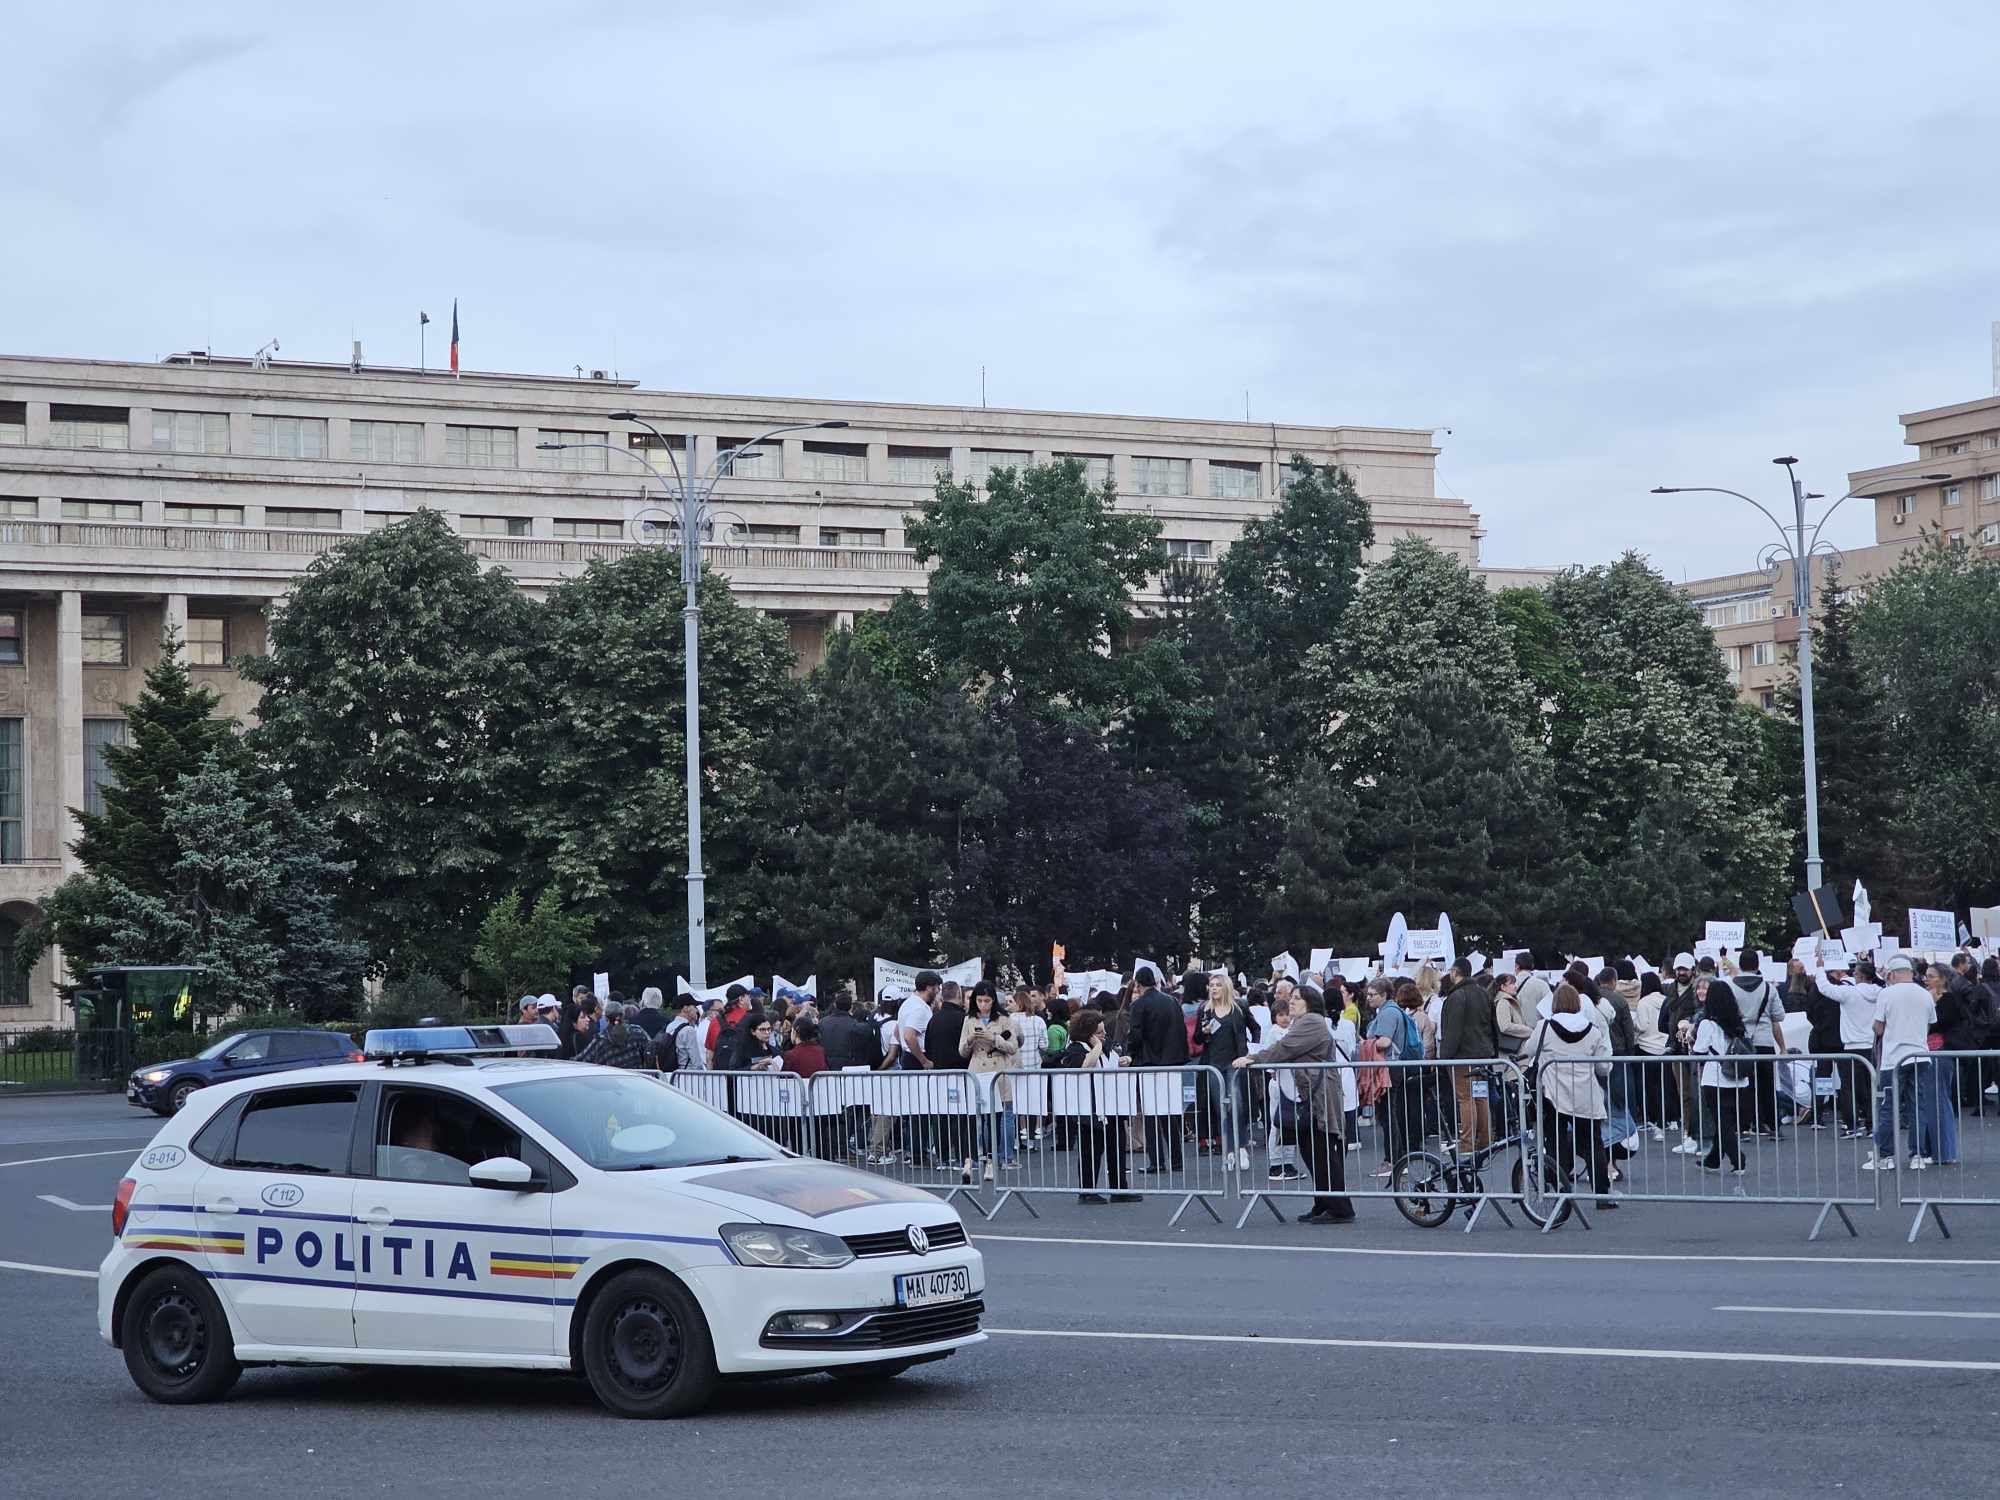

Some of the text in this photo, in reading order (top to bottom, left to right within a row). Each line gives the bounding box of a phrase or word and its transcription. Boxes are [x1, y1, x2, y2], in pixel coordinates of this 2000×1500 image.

[148, 1152, 176, 1164] B-014
[280, 1189, 296, 1201] 112
[257, 1227, 477, 1281] POLITIA
[906, 1271, 965, 1299] MAI 40730
